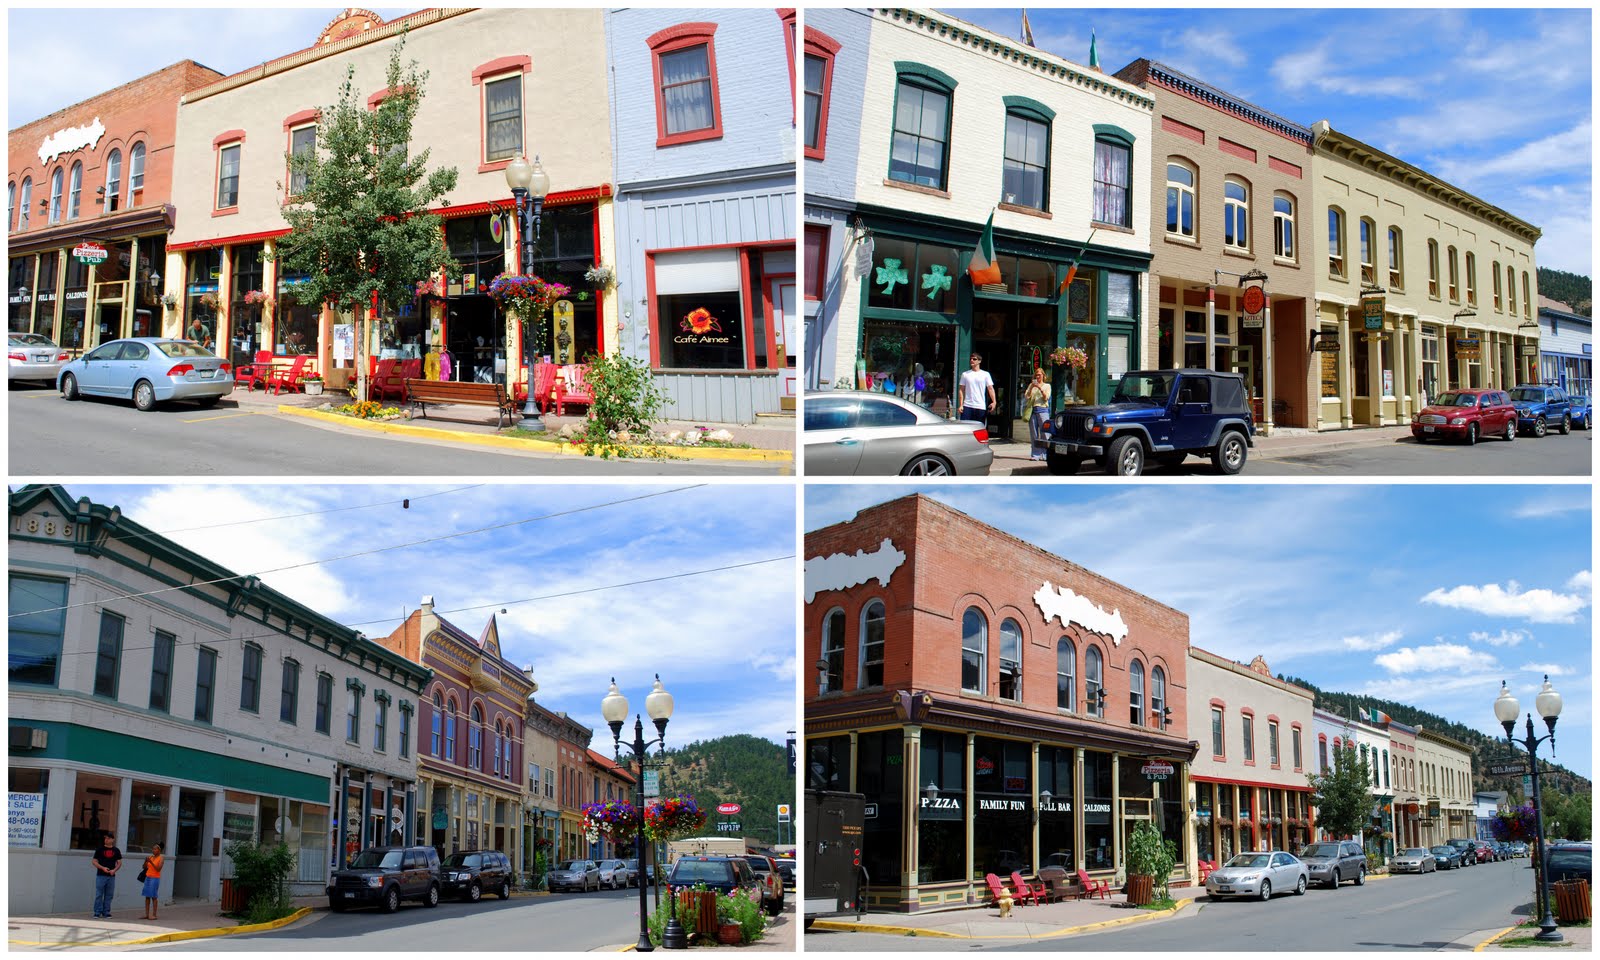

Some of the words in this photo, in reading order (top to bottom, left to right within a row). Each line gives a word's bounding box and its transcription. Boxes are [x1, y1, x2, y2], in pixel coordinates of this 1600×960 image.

[76, 249, 105, 257] Pizzeria
[66, 292, 88, 300] CALZONES
[699, 335, 729, 344] Aimee
[16, 516, 73, 537] 1886
[1144, 766, 1171, 774] Pizzeria
[921, 797, 960, 809] PZZA
[980, 799, 1009, 810] FAMILY
[1010, 800, 1026, 811] FUN
[1058, 802, 1071, 812] BAR
[1084, 804, 1111, 812] CALZONES
